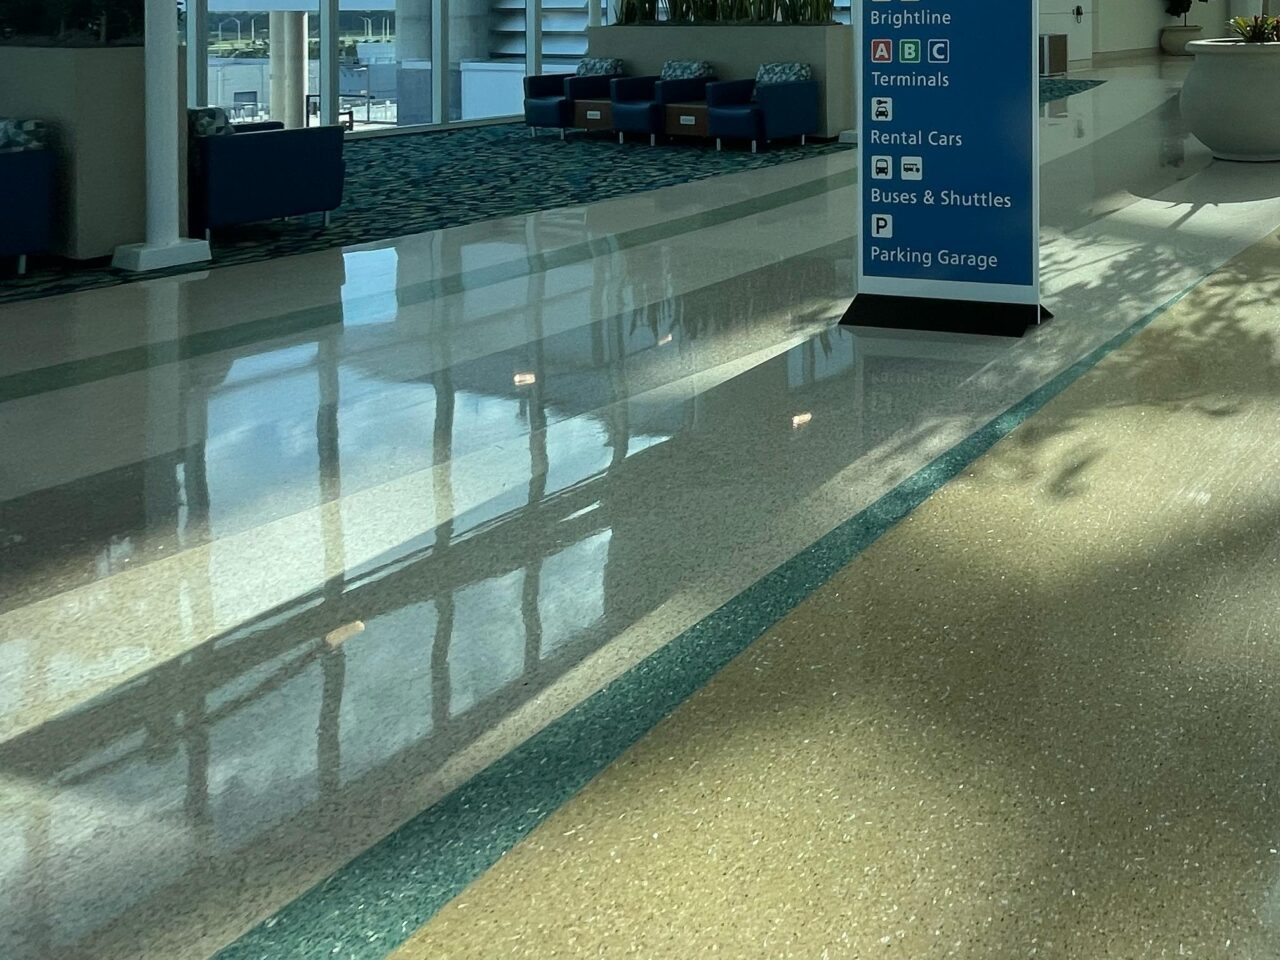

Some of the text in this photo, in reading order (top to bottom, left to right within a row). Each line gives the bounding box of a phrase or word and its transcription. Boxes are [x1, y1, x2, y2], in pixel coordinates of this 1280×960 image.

[871, 10, 951, 28] Brightline
[874, 43, 945, 59] A B C
[871, 71, 949, 87] Terminals
[871, 130, 963, 146] Rental Cars
[871, 188, 1012, 208] Buses & Shuttles
[876, 217, 888, 234] P
[871, 246, 998, 270] Parking Garage
